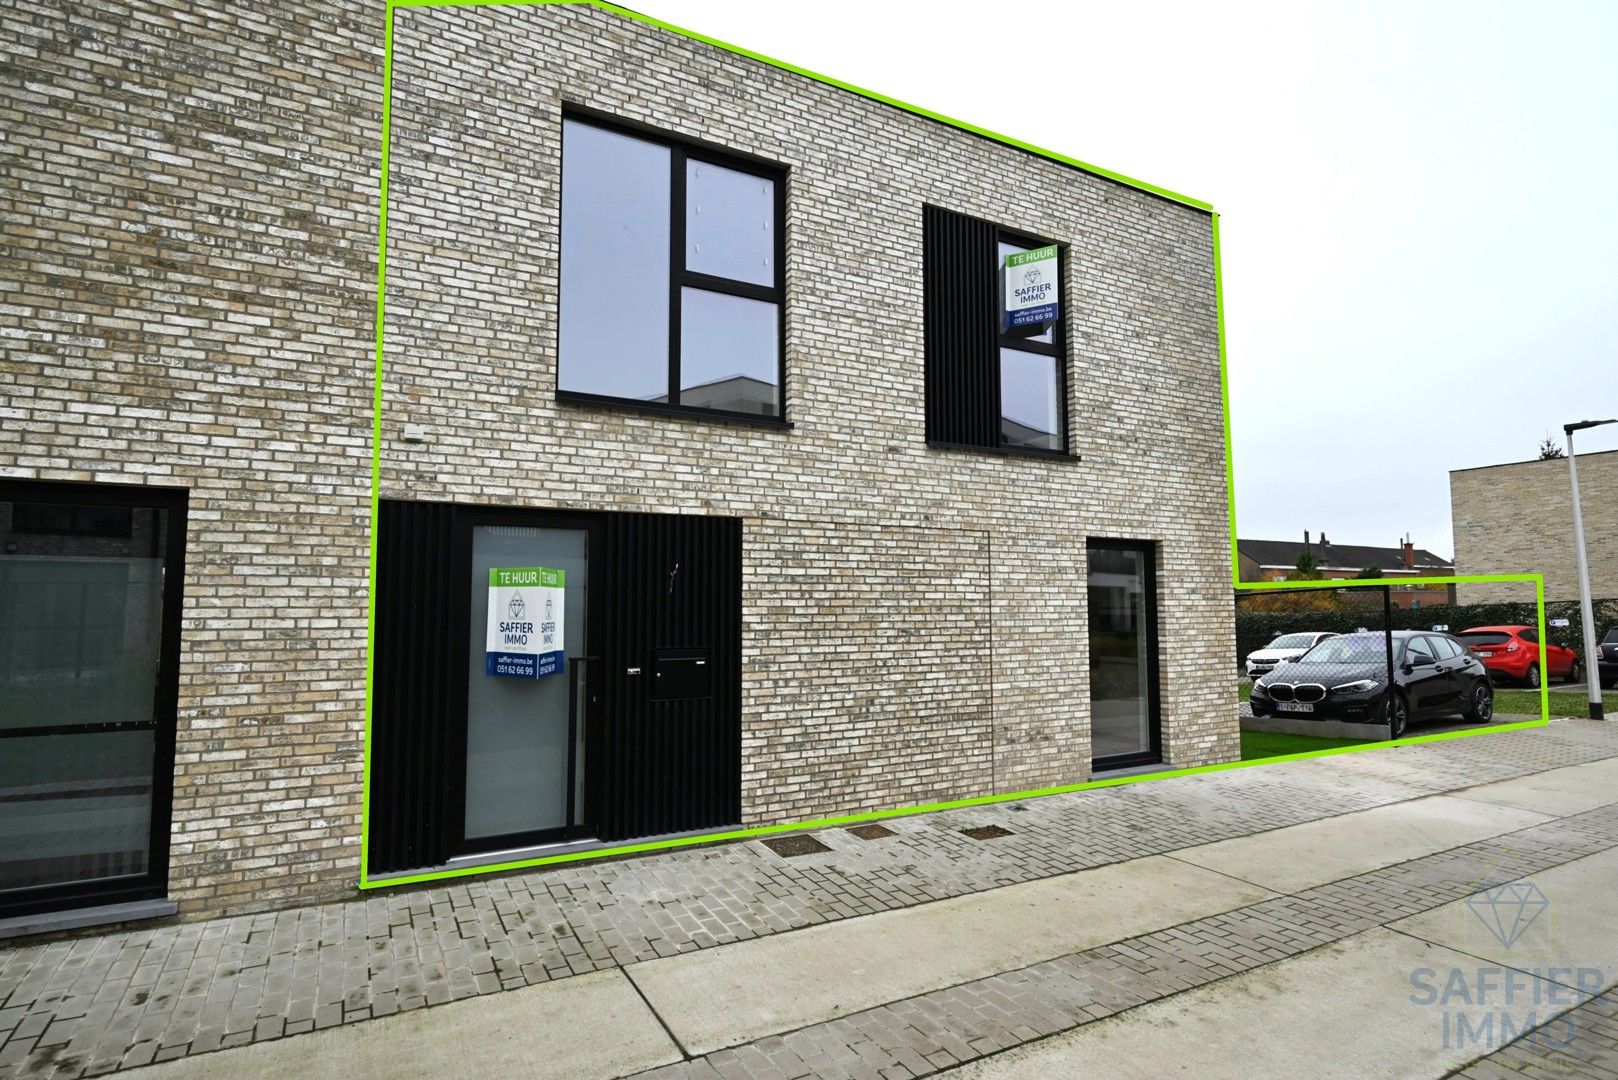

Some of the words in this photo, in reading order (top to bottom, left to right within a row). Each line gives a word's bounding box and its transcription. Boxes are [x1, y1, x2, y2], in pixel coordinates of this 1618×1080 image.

[1012, 255, 1024, 265] TE
[1026, 248, 1054, 262] HUUR
[1014, 282, 1051, 297] SAFFIER
[1020, 292, 1046, 304] IMMO
[1013, 317, 1025, 325] 051
[1035, 313, 1044, 321] 66
[1044, 311, 1053, 319] 99
[1014, 306, 1052, 318] saffier-immo.be
[500, 572, 511, 584] TE
[512, 571, 538, 584] HUUR
[499, 621, 534, 634] SAFFIER
[504, 633, 528, 646] IMMO
[498, 655, 533, 665] saffier-immo.be
[496, 664, 508, 674] 051
[508, 665, 516, 674] 62
[516, 666, 525, 675] 66
[525, 666, 534, 676] 99
